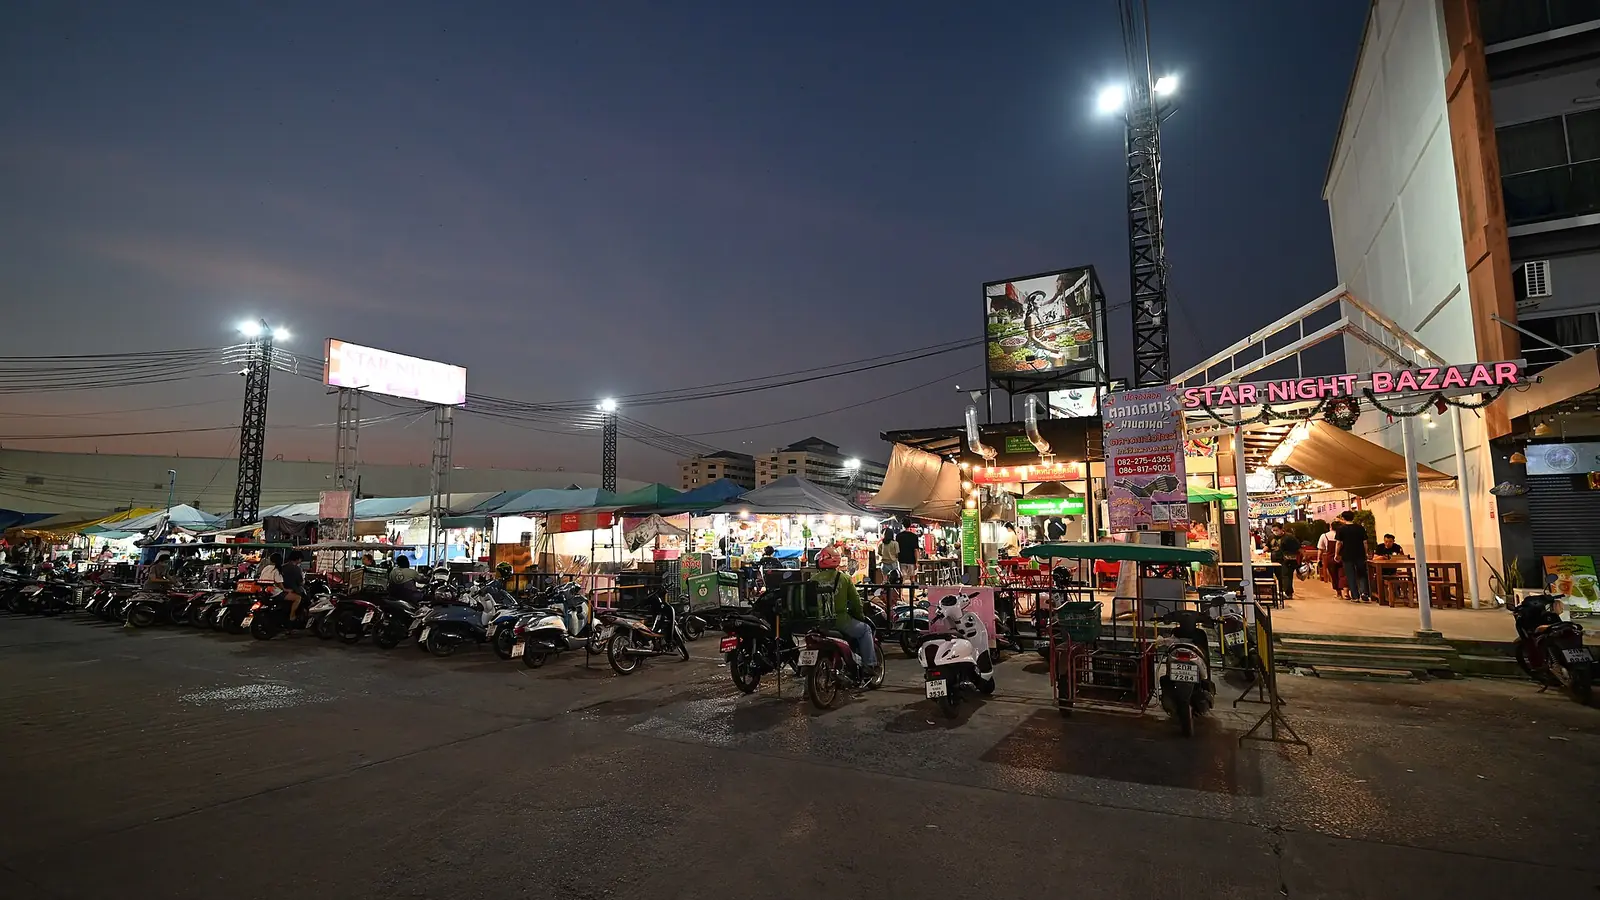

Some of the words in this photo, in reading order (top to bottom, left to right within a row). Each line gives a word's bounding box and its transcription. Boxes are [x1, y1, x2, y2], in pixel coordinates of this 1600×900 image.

[1184, 384, 1256, 408] STAR
[1267, 374, 1359, 402] NIGHT
[1373, 363, 1518, 393] BAZAAR
[1109, 397, 1172, 418] ตลาดสตาร์
[1121, 420, 1163, 431] มาบตาพุด
[1117, 456, 1172, 466] 082-275-4365
[1118, 464, 1171, 475] 086-817-9021
